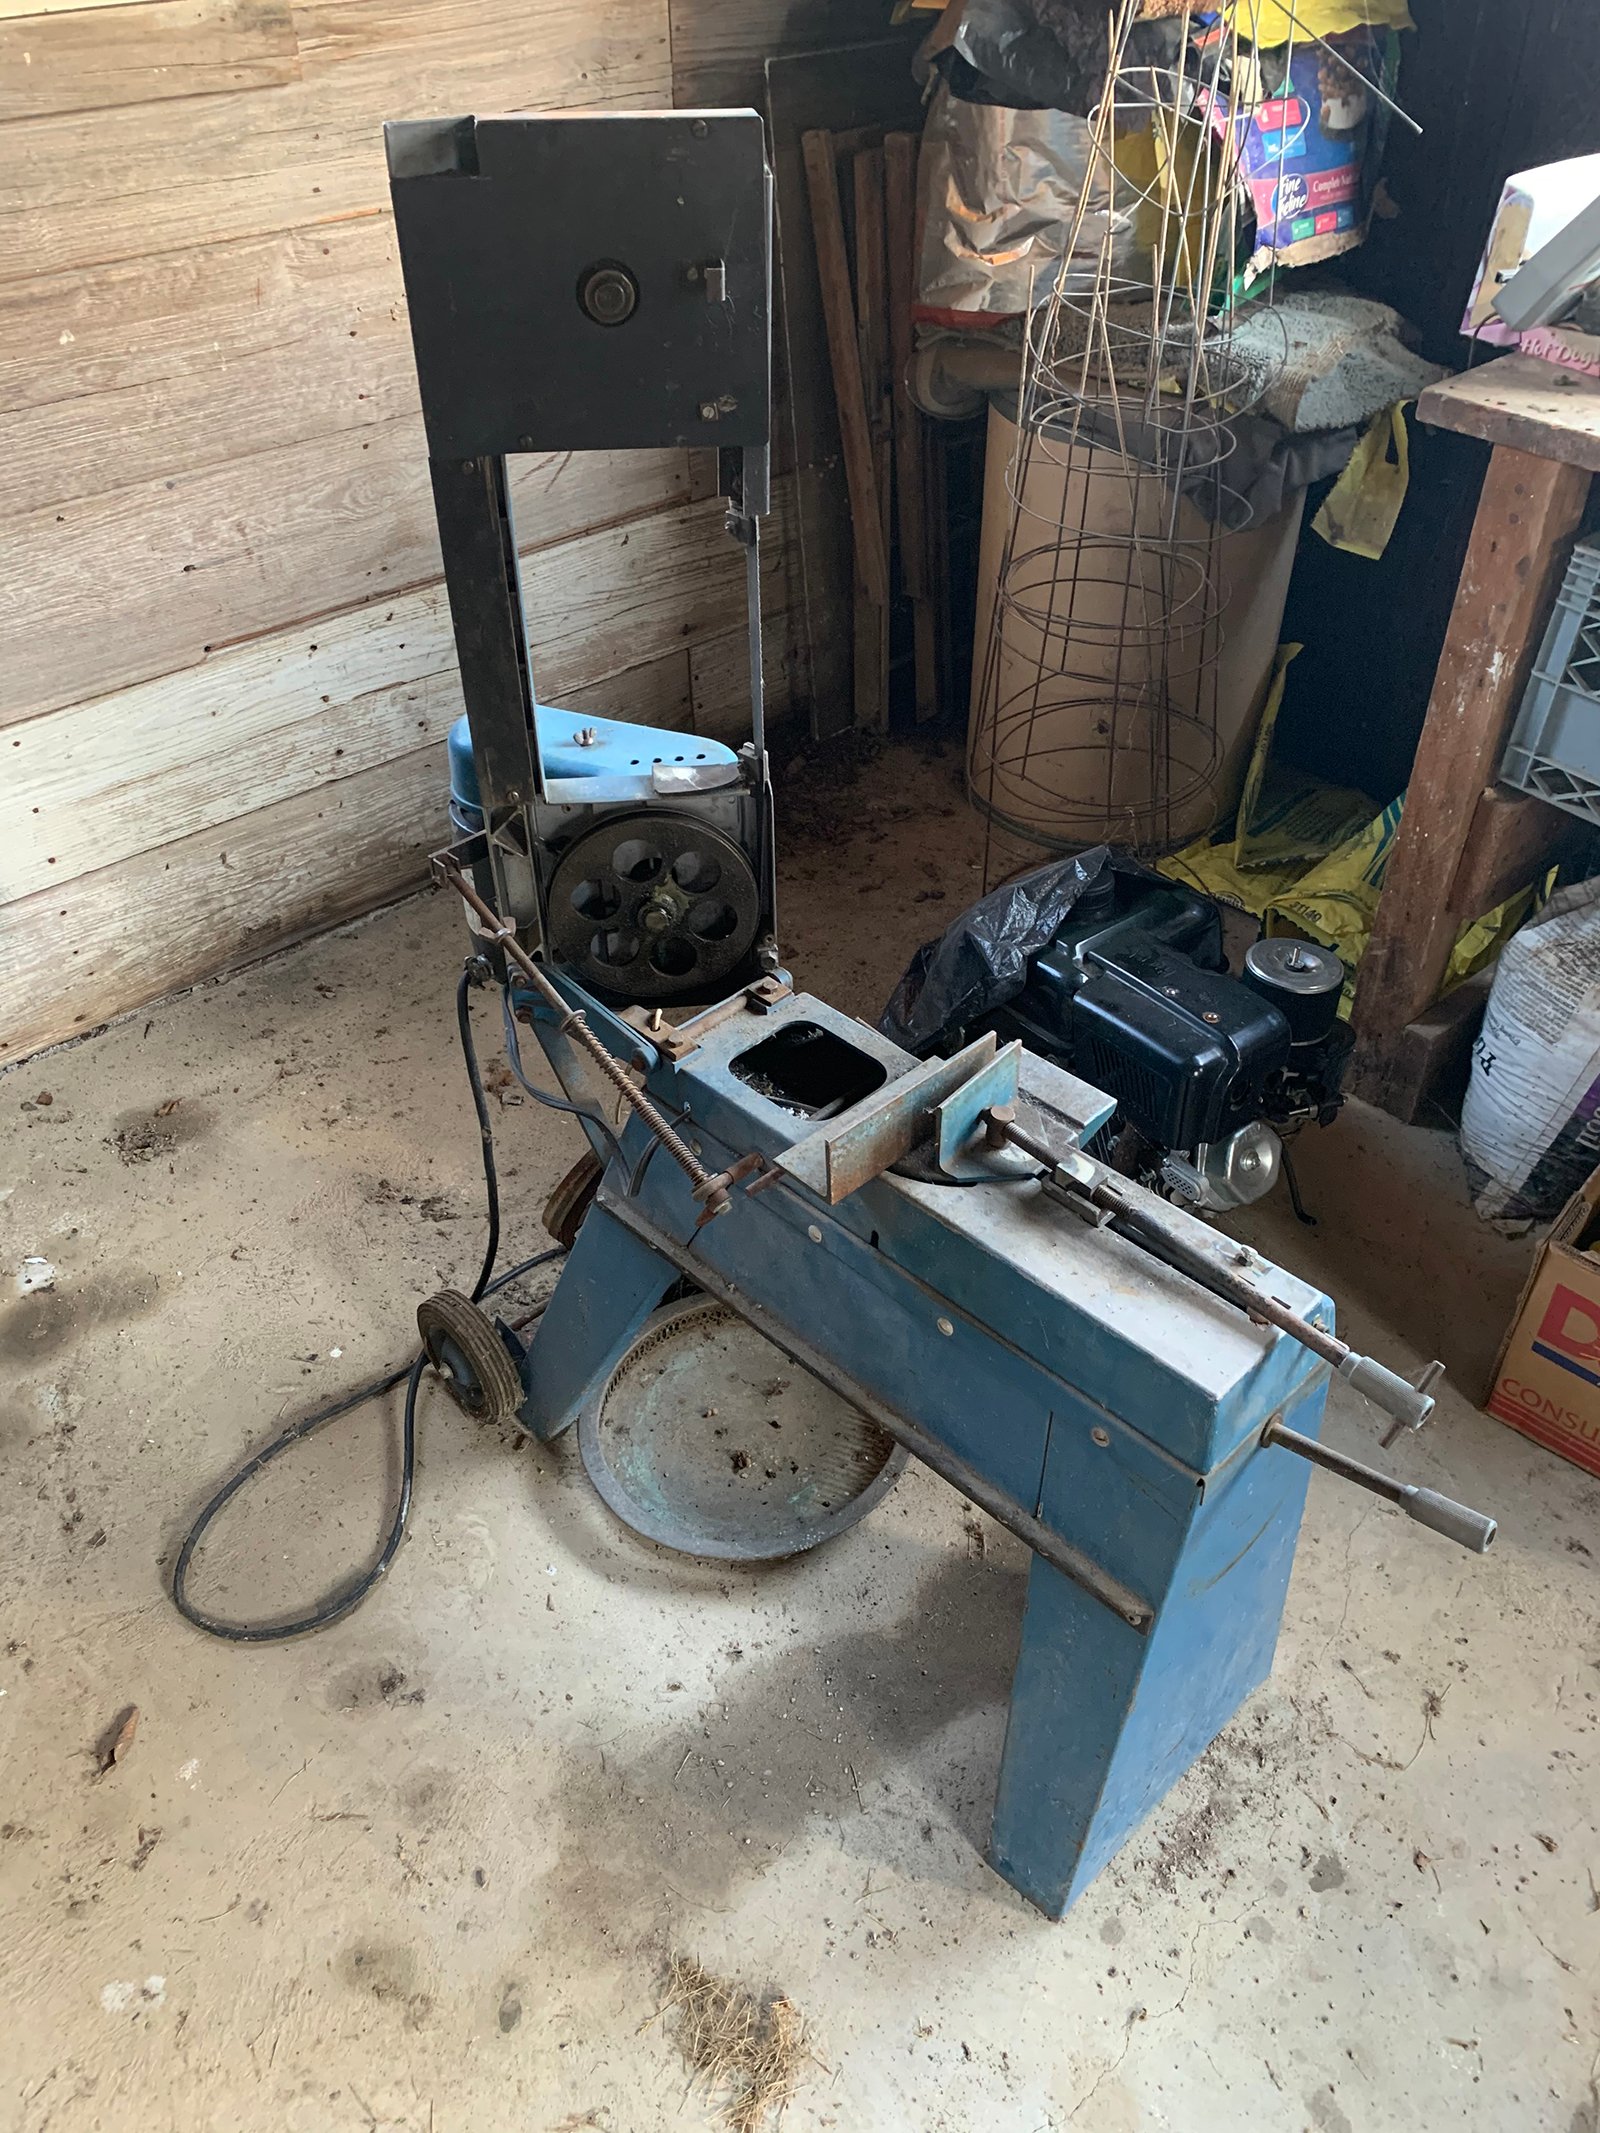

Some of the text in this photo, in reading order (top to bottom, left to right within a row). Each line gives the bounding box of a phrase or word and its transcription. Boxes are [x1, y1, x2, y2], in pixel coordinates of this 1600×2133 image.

[1280, 174, 1302, 197] Fine
[1312, 175, 1340, 193] Complet
[1279, 192, 1307, 217] Feline
[1520, 339, 1554, 359] Hot
